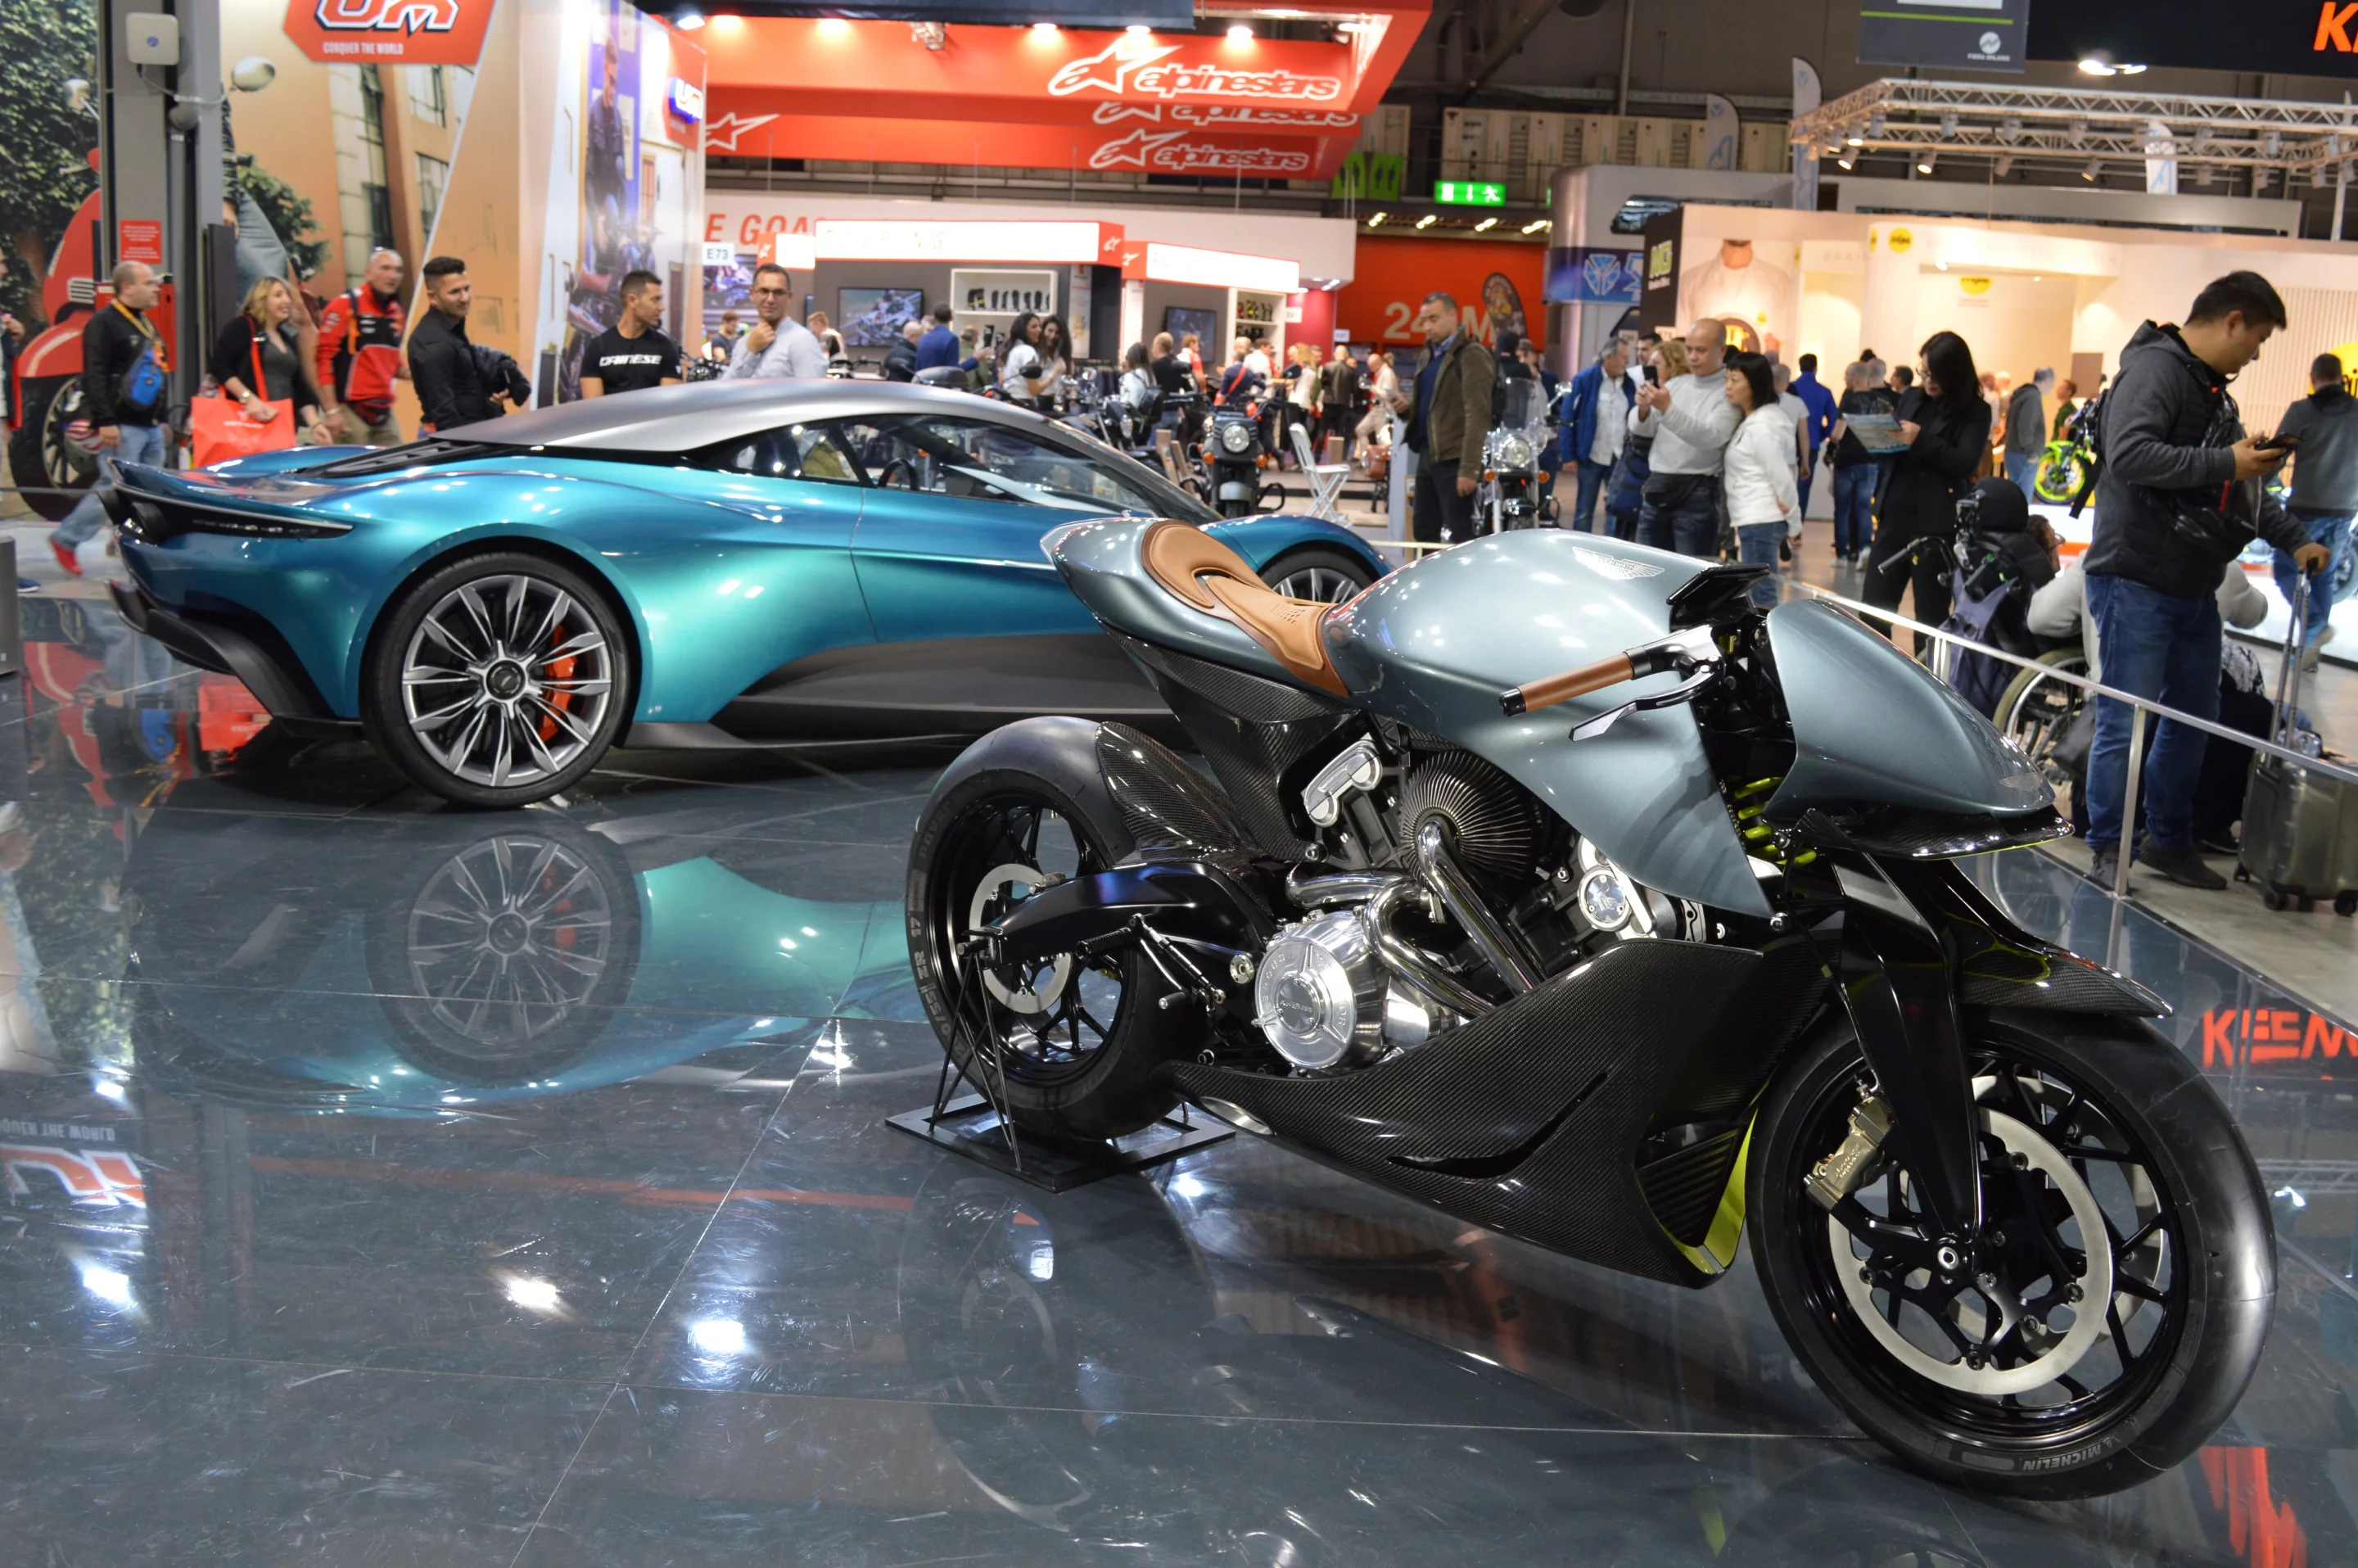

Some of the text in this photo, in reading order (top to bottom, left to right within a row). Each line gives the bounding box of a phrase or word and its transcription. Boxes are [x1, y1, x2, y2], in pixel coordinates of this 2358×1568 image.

[323, 42, 404, 56] CONQUER THE WORLD
[707, 248, 729, 260] E73
[599, 354, 662, 367] DAINESE
[910, 916, 922, 938] 17
[2021, 1444, 2103, 1471] MICHELIN
